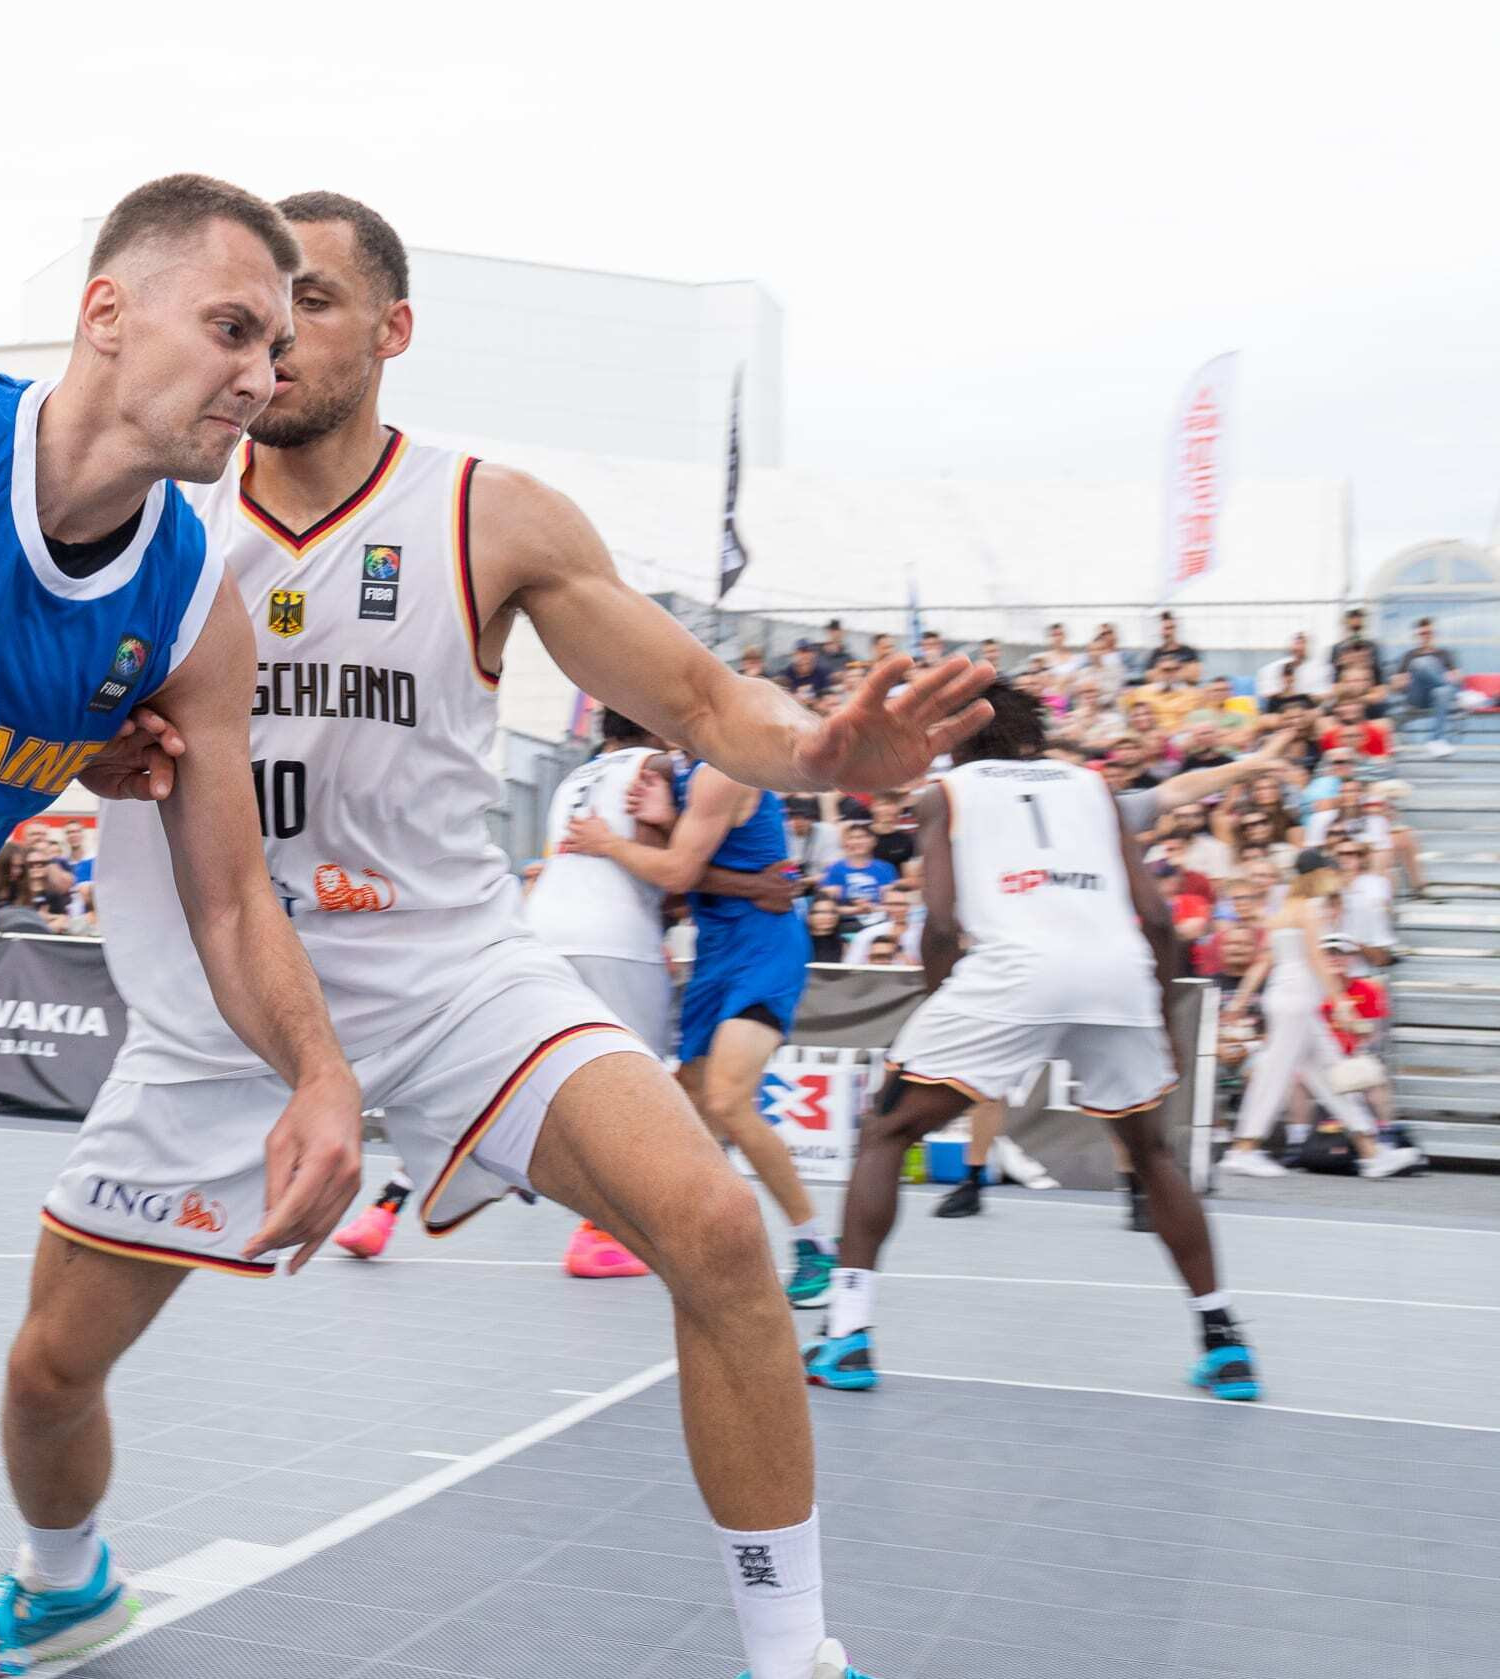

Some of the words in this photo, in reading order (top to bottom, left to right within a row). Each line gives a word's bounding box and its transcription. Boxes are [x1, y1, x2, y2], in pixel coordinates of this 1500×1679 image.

[364, 587, 394, 602] FIBA
[99, 681, 128, 698] FIBA
[87, 1175, 172, 1223] ING
